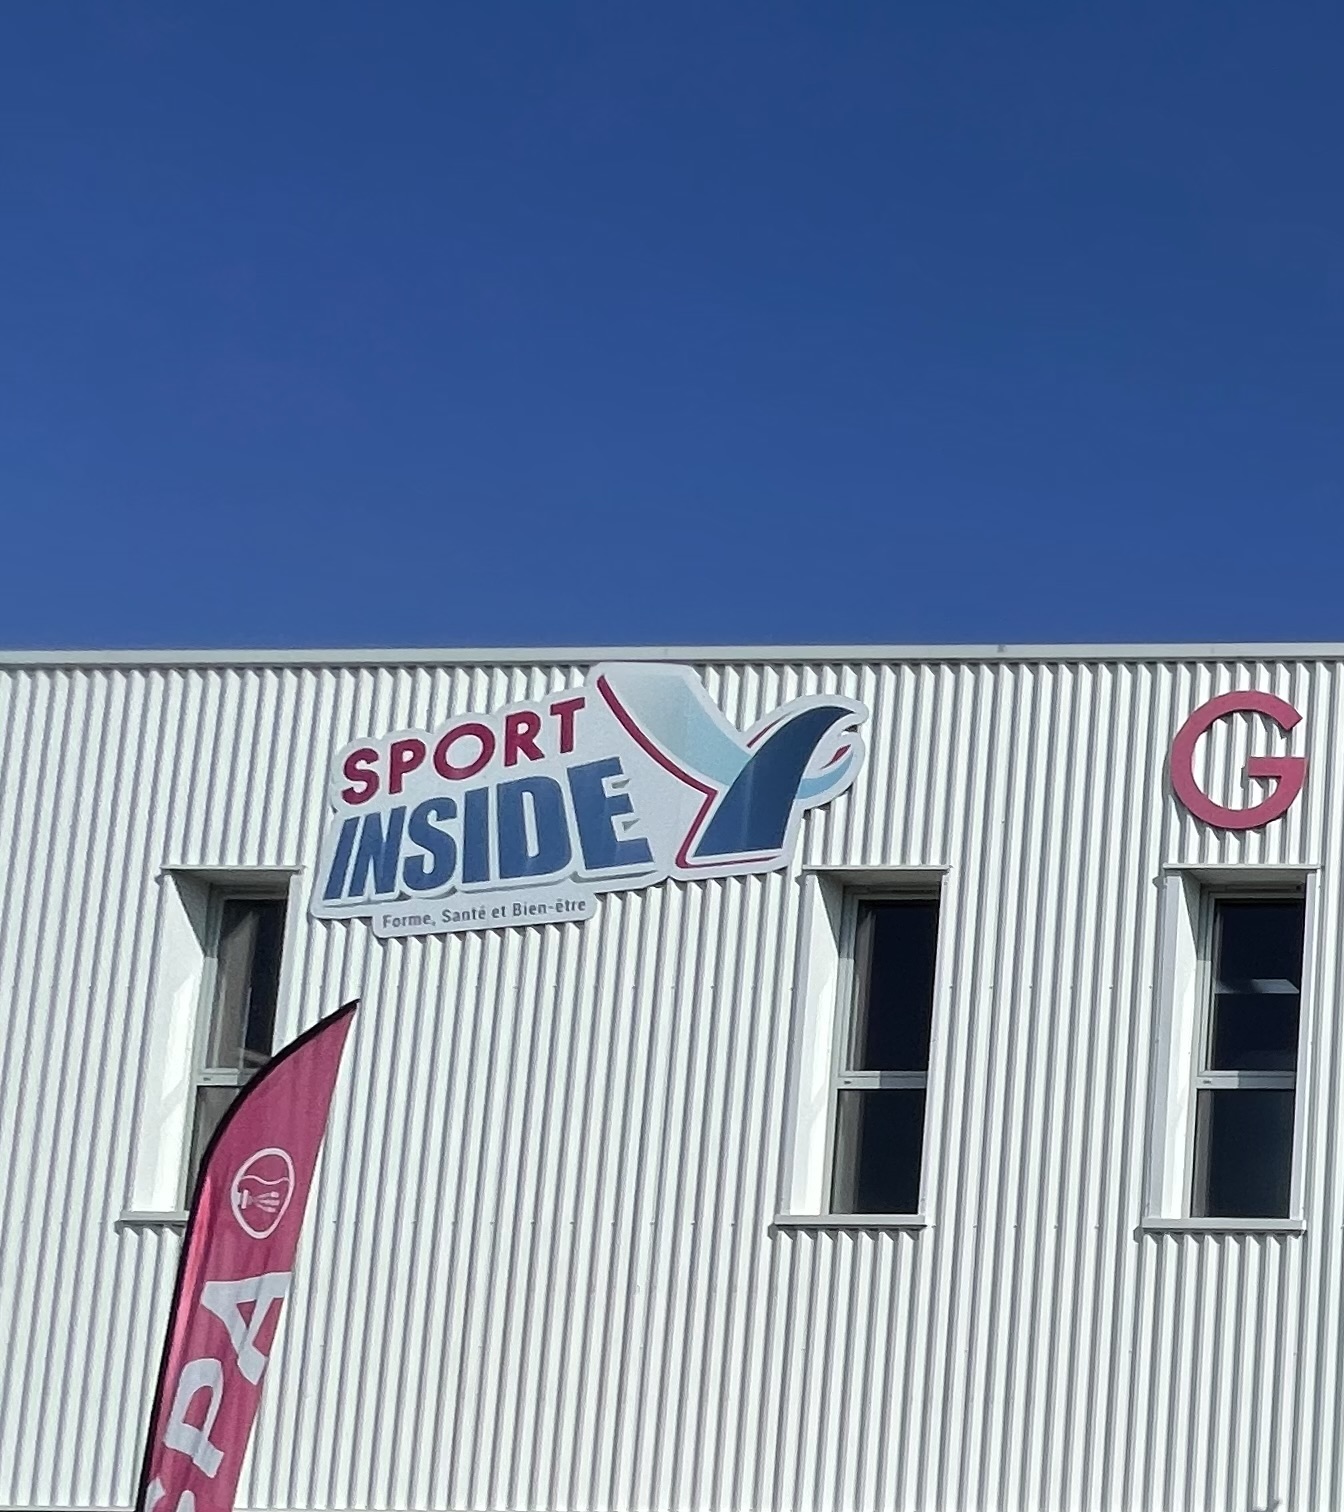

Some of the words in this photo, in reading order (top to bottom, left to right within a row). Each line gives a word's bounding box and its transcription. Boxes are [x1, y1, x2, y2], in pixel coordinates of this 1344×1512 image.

[341, 697, 586, 806] SPORT
[322, 756, 655, 901] INSIDE
[441, 905, 486, 923] Santé
[491, 905, 506, 919] et
[512, 898, 586, 917] Bien-être
